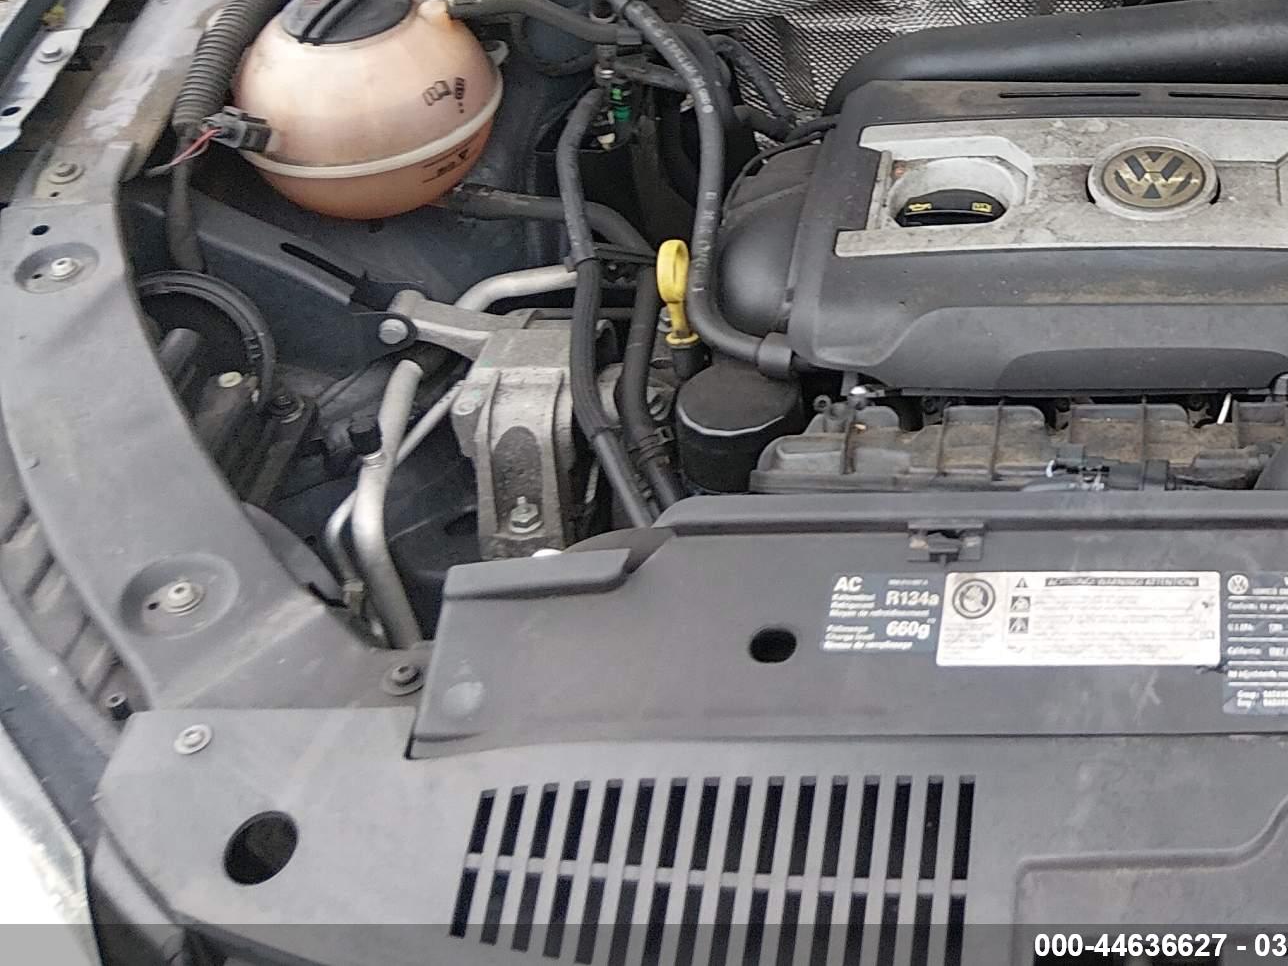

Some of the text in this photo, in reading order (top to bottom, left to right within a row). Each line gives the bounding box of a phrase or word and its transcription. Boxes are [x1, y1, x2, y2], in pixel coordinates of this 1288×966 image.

[833, 576, 863, 592] AC
[885, 590, 940, 606] R134a
[886, 620, 931, 639] 660g
